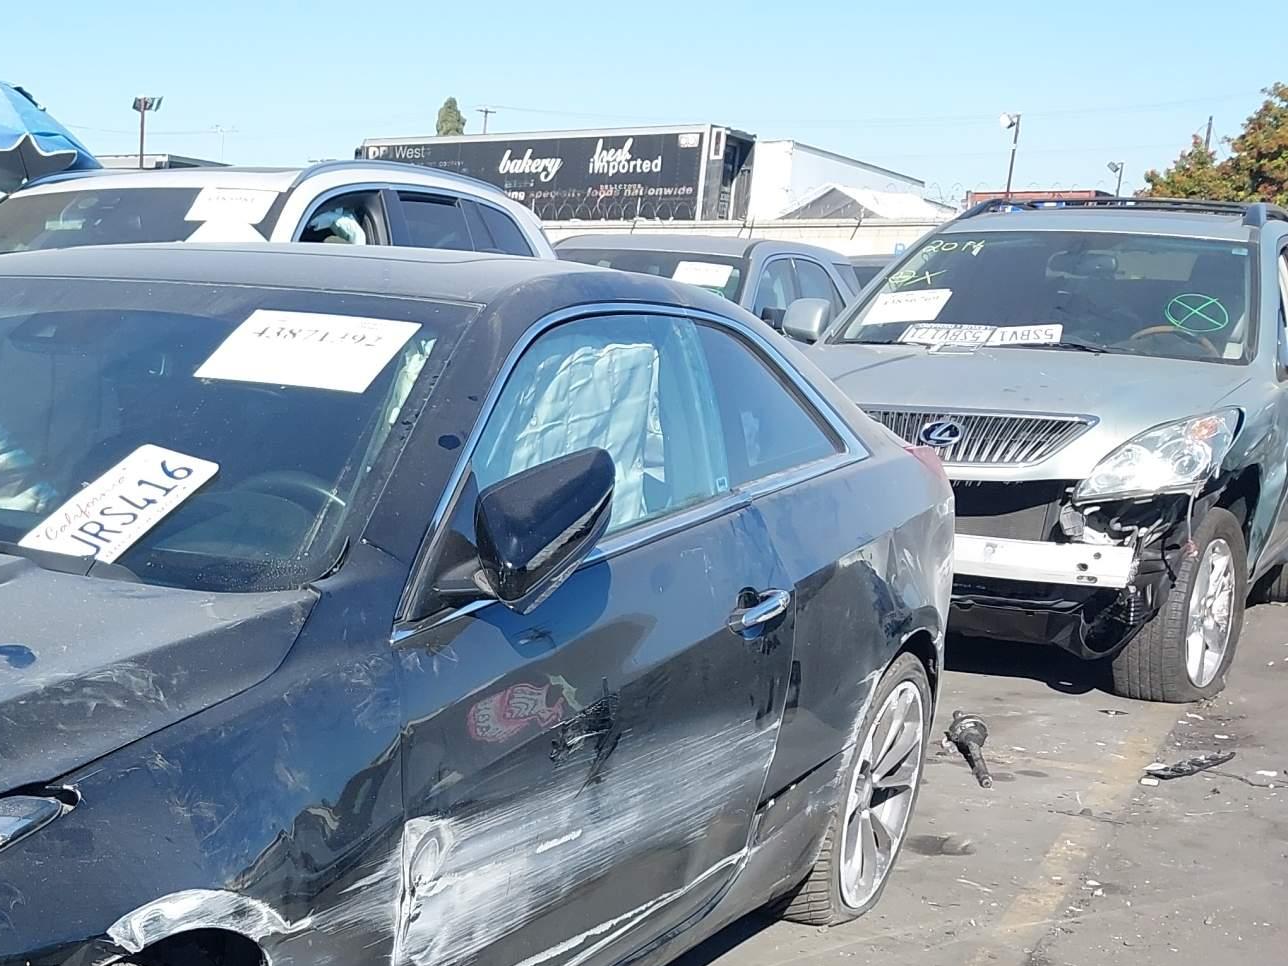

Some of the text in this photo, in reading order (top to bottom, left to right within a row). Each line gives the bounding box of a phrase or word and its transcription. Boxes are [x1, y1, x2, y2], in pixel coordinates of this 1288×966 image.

[395, 145, 425, 160] West
[498, 148, 564, 183] bakery
[588, 155, 663, 177] imported
